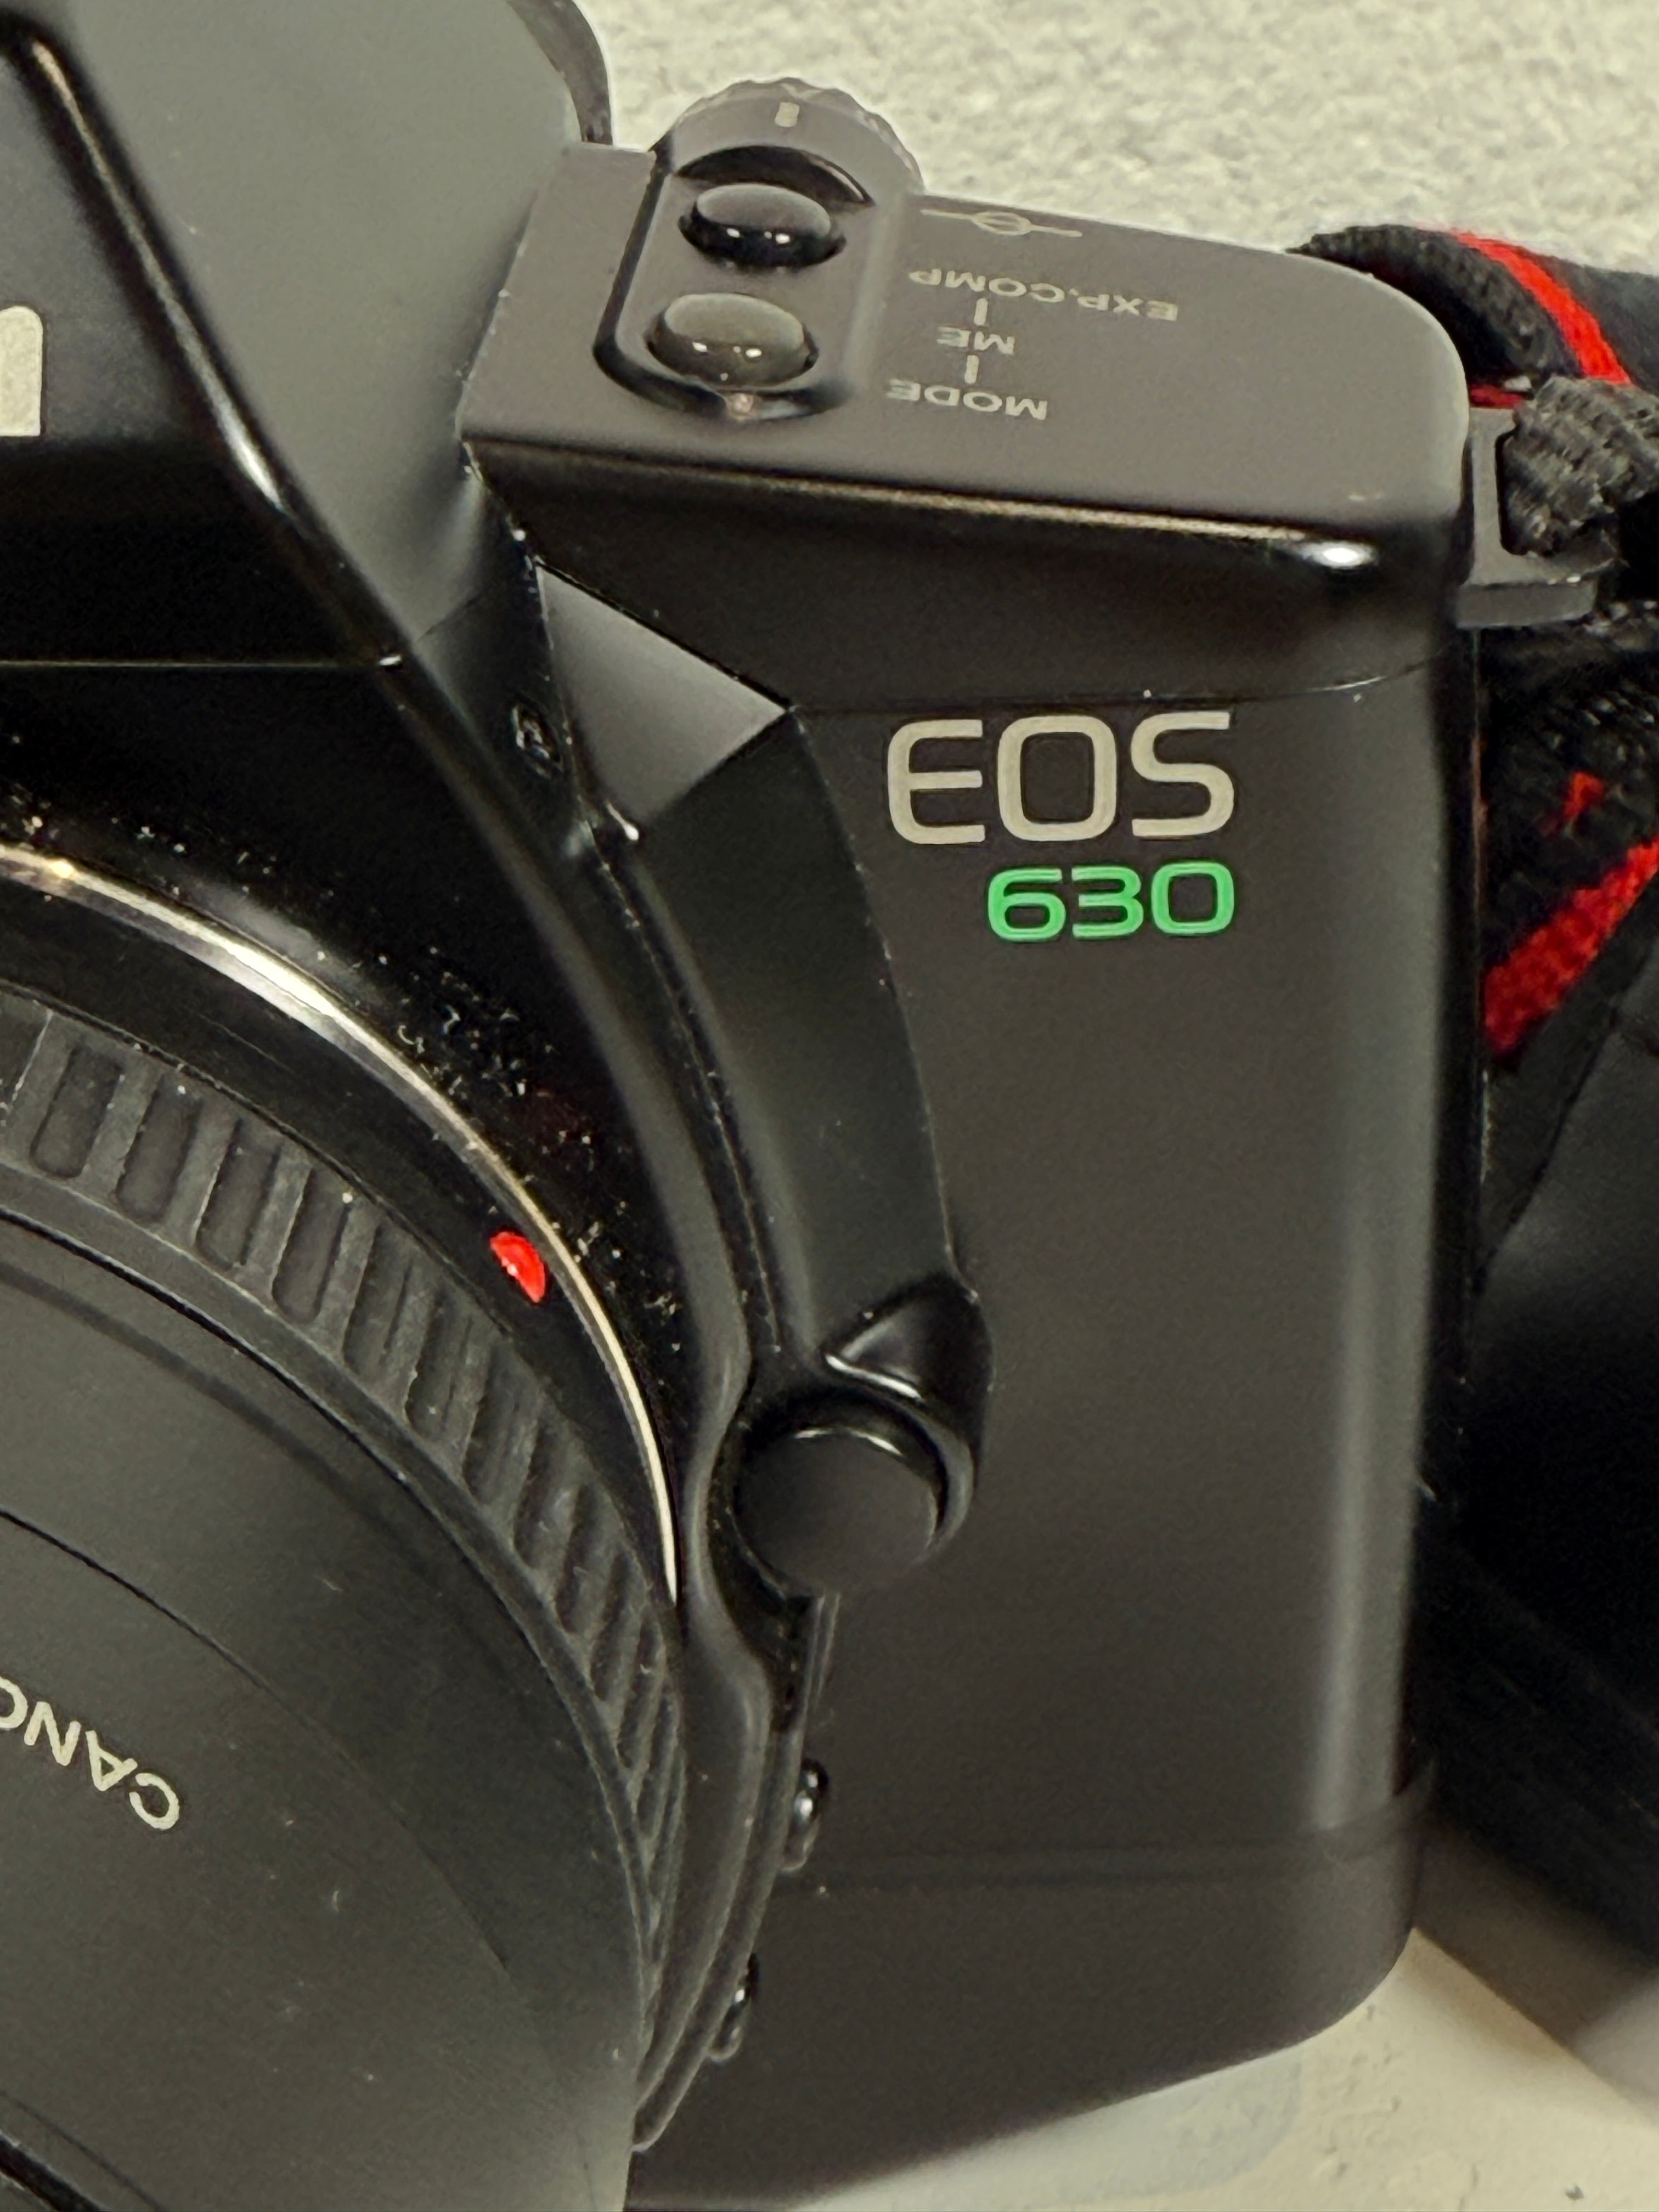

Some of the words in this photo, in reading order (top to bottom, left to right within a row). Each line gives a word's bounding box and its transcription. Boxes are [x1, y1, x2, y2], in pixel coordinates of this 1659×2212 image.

[936, 326, 1015, 356] ME
[886, 379, 1048, 420] MODE
[887, 711, 1234, 845] EOS
[988, 860, 1234, 942] 630
